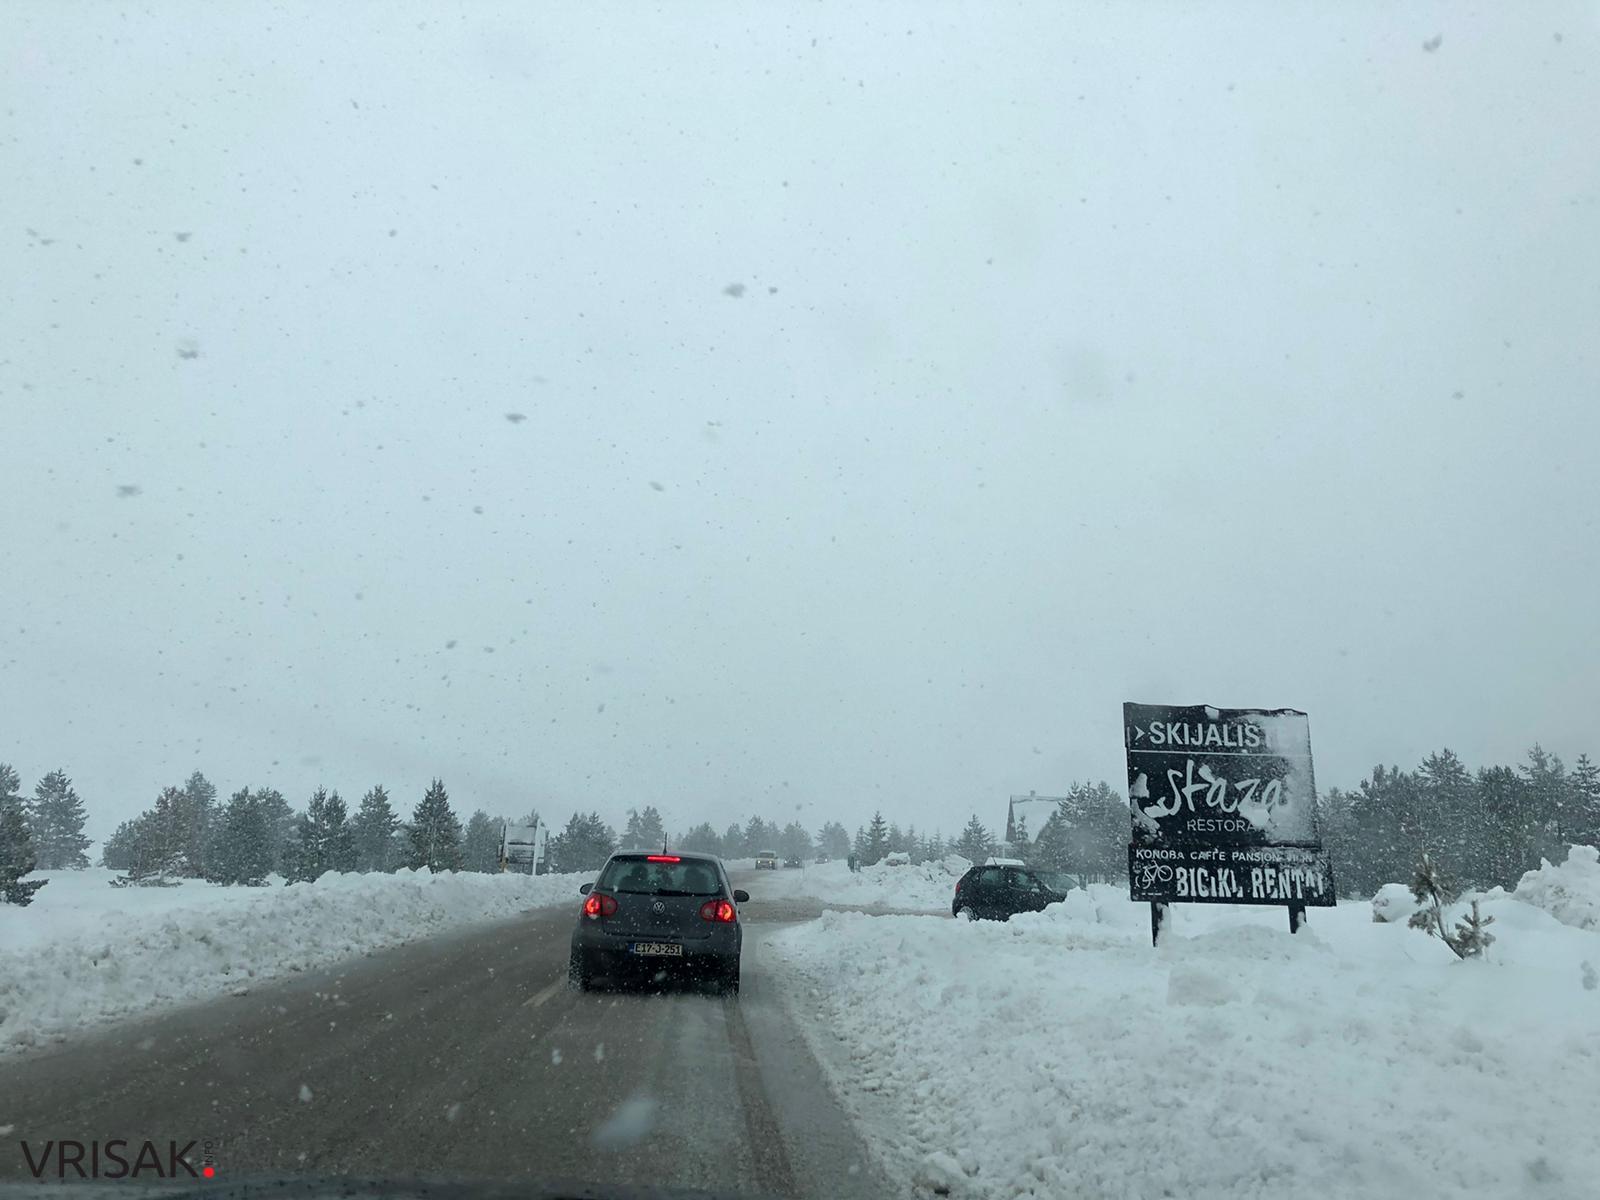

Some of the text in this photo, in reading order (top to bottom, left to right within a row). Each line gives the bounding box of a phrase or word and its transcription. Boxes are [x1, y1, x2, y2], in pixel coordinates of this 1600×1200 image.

[1149, 721, 1261, 748] SKIJALIS
[1186, 818, 1257, 832] RESTORA
[1135, 848, 1185, 860] KONOBA
